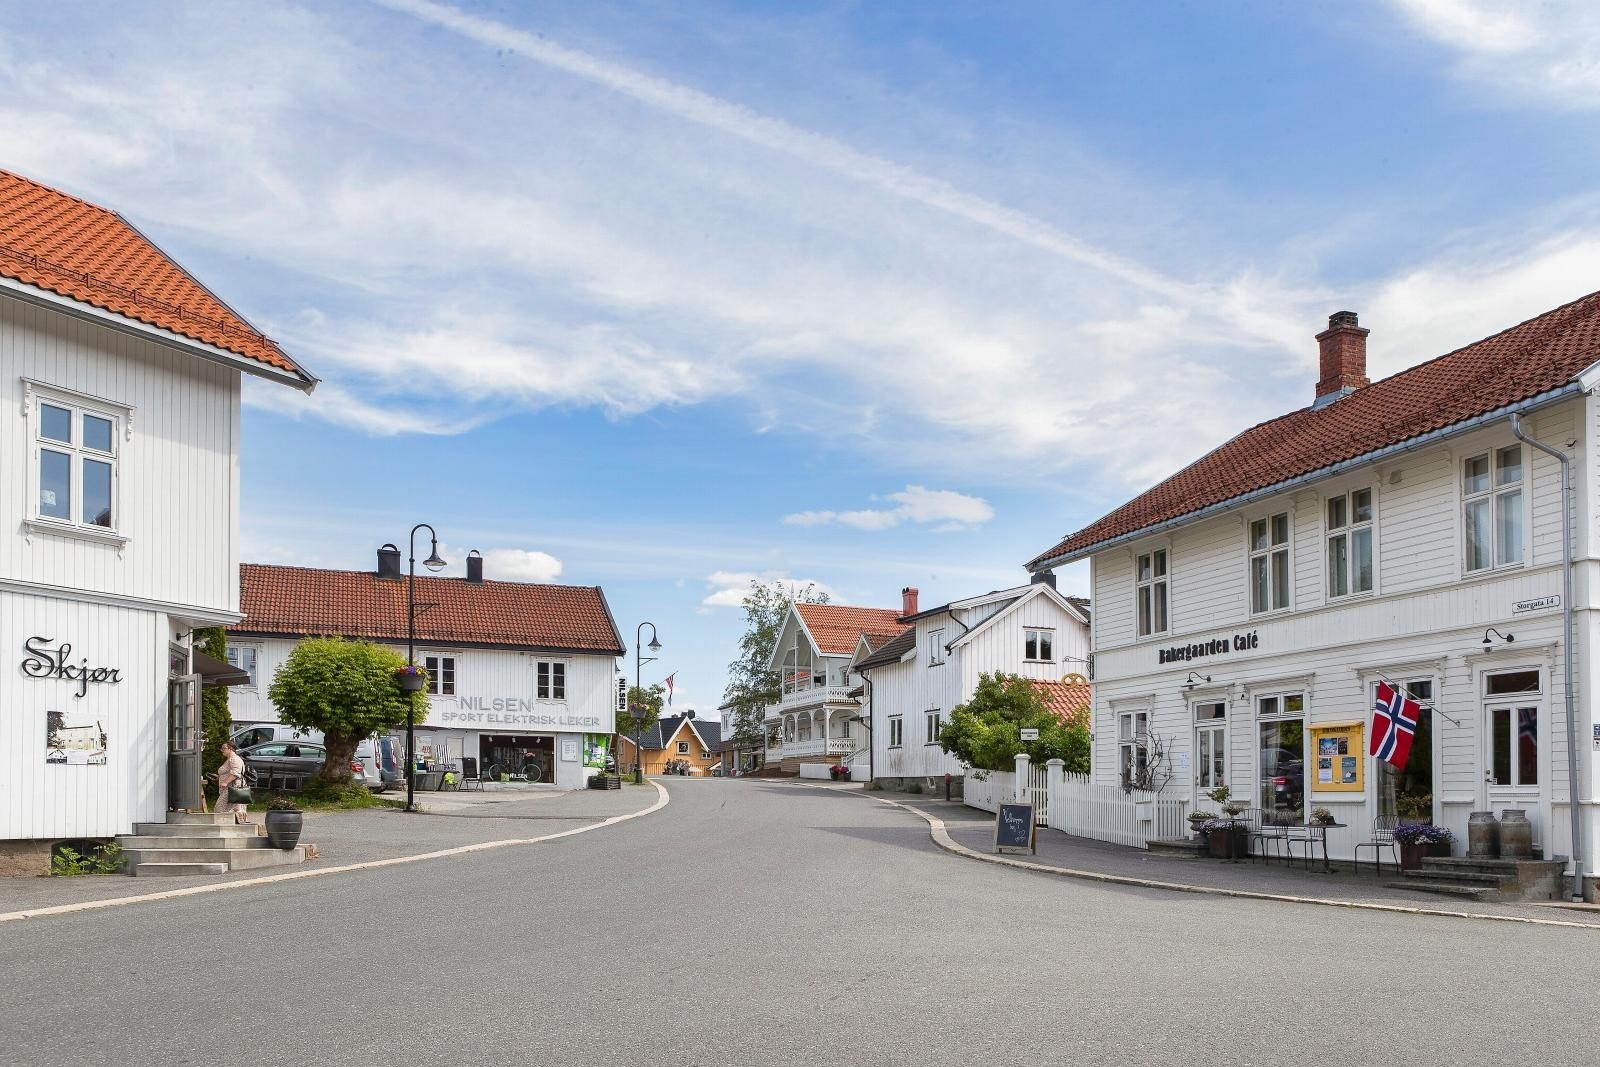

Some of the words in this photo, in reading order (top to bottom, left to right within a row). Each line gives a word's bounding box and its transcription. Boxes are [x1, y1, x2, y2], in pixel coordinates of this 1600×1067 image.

[1516, 601, 1544, 610] Storgata
[1159, 639, 1229, 664] Bakergaarden
[1233, 630, 1258, 651] Café
[21, 636, 124, 698] Skjør
[460, 696, 532, 712] NILSEN
[618, 678, 626, 710] NILSEN
[441, 712, 484, 723] SPORT
[487, 713, 557, 725] ELEKTRISK
[559, 716, 600, 726] LEKER
